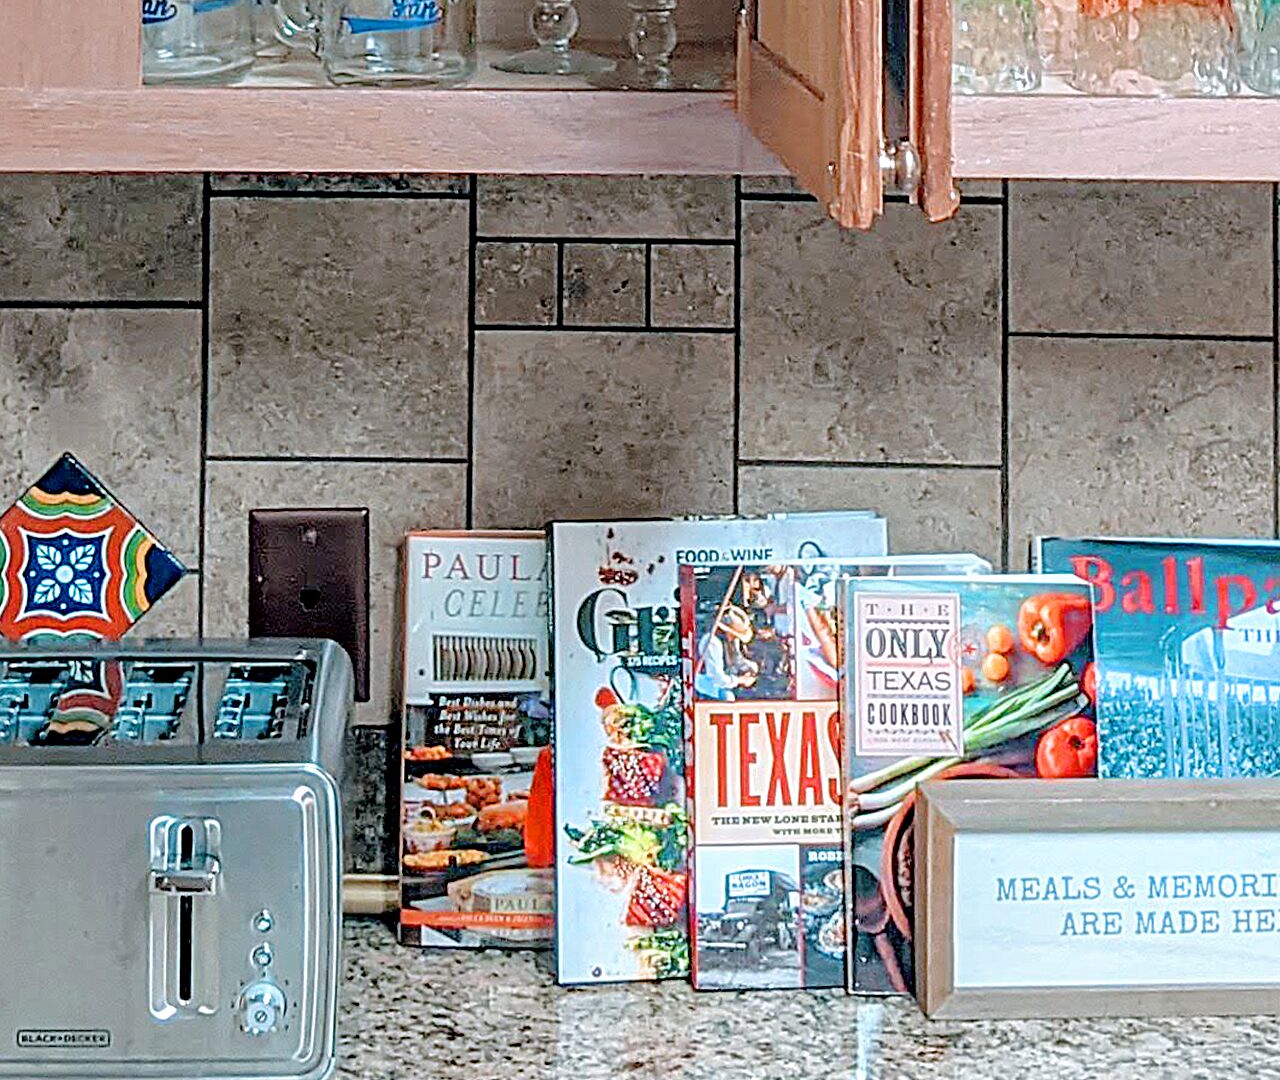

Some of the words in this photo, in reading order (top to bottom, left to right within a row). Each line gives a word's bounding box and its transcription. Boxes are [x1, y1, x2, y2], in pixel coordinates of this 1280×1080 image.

[676, 549, 719, 563] FOOD
[865, 627, 950, 660] ONLY
[866, 671, 951, 691] TEXAS
[867, 703, 952, 725] COOKBOOK
[711, 816, 739, 825] THE
[742, 815, 771, 825] NEW
[774, 814, 808, 824] LONE
[996, 876, 1101, 901] MEALS
[1113, 875, 1136, 899] &
[1060, 911, 1122, 935] ARE
[1135, 910, 1220, 934] MADE
